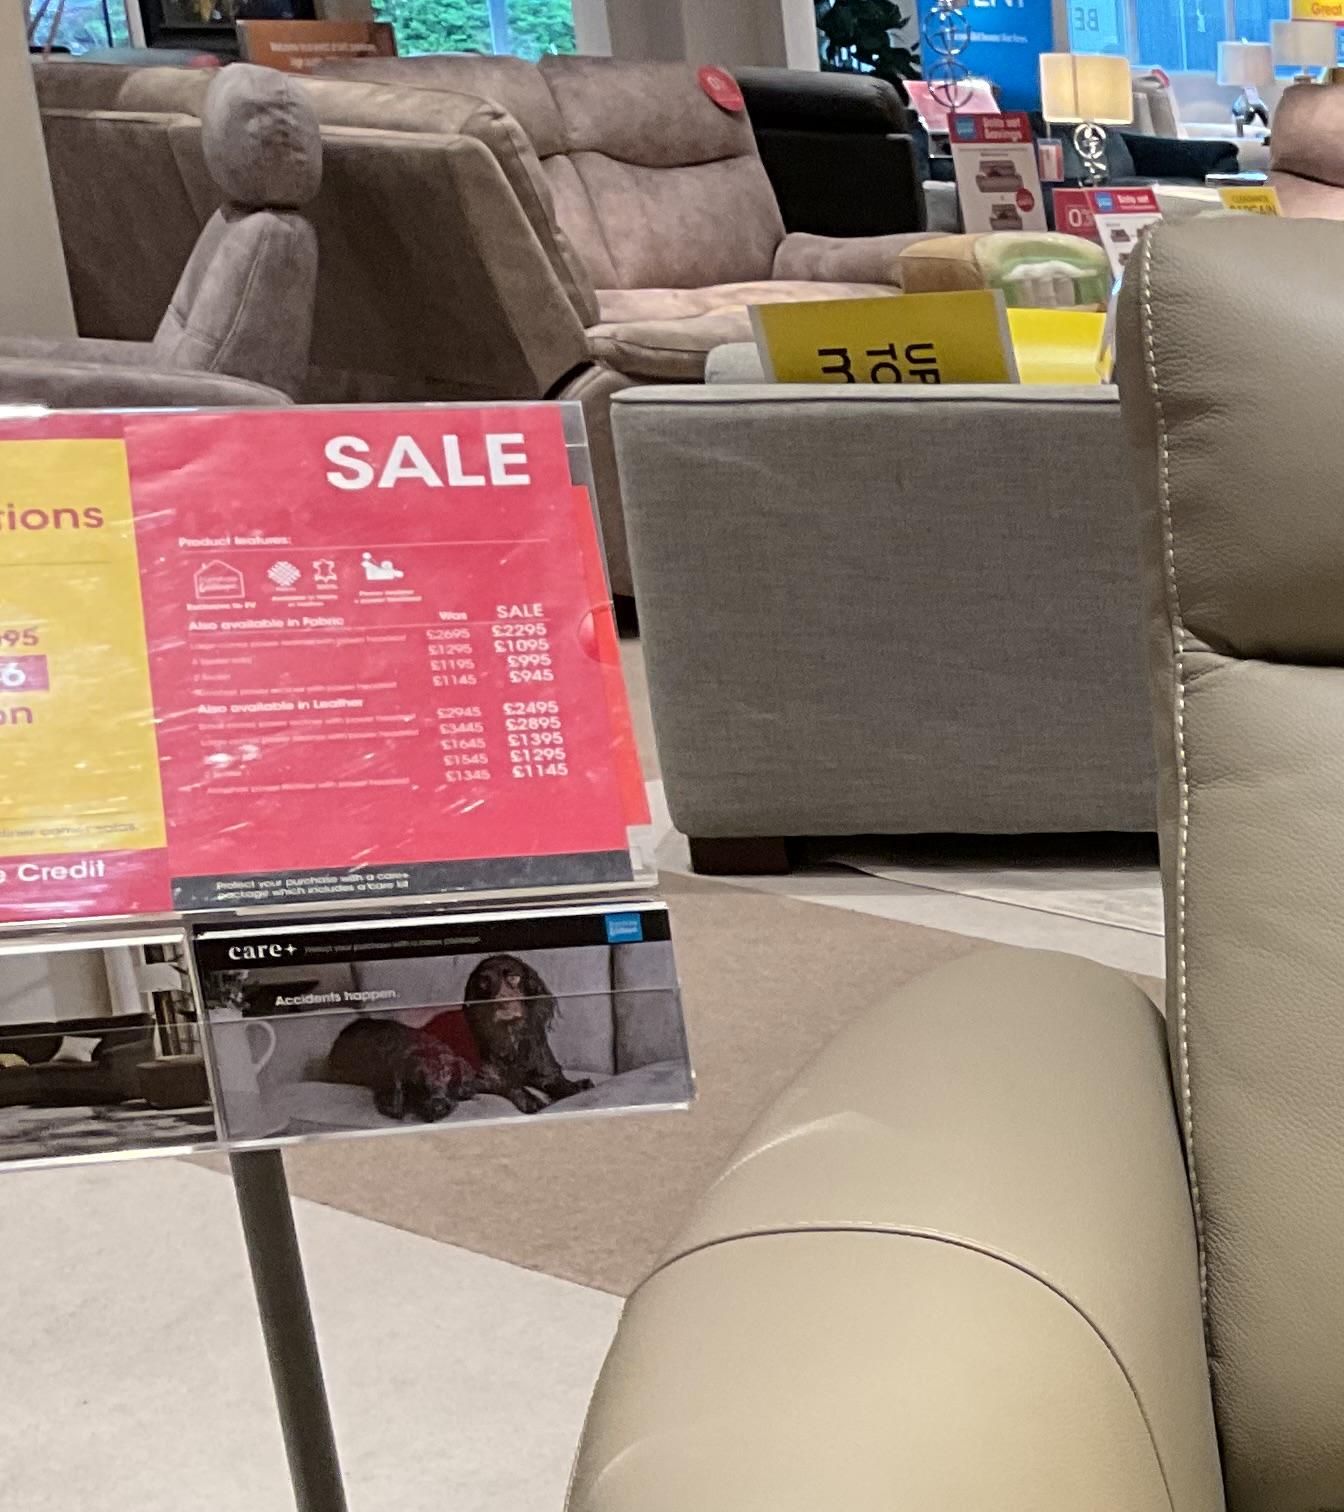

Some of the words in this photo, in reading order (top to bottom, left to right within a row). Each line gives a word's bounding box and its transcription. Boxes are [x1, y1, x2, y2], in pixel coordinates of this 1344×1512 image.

[324, 432, 531, 490] SALE
[0, 502, 104, 531] ions
[496, 602, 544, 618] SALE
[0, 628, 39, 647] 95
[491, 623, 547, 637] £2295
[494, 638, 550, 653] £1095
[507, 653, 552, 668] £995
[509, 668, 554, 683] £945
[503, 700, 559, 716] £2495
[507, 731, 564, 747] £1395
[510, 747, 566, 762] £1295
[512, 762, 568, 778] £1145
[18, 859, 106, 882] Credit
[228, 943, 298, 960] care+
[275, 990, 342, 1006] Accidents
